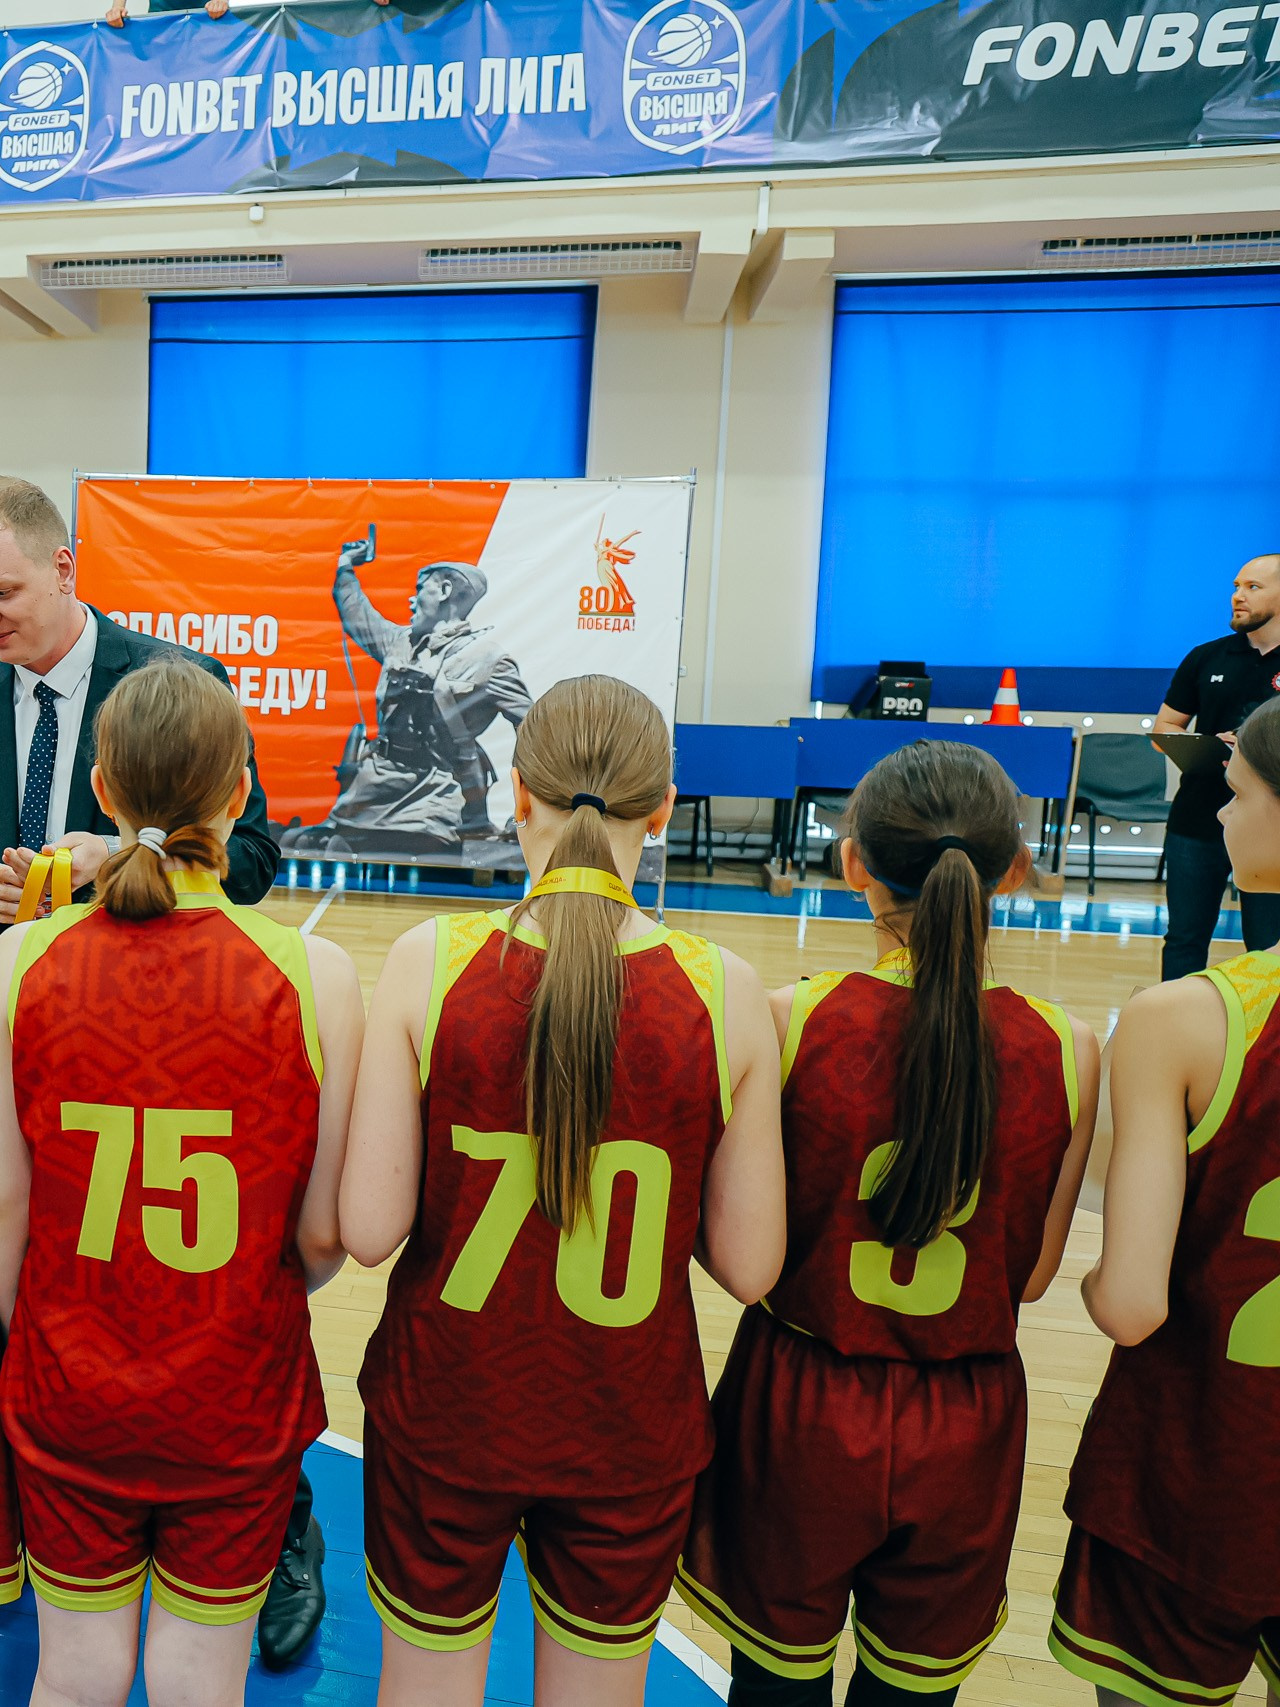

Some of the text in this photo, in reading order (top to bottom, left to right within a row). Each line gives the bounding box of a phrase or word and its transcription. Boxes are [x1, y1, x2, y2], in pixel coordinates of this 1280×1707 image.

[652, 72, 716, 87] FONBET
[120, 52, 587, 139] FONBET ВЫСШАЯ ЛИГА
[639, 91, 729, 122] ВЫСШАЯ
[13, 114, 65, 127] FONBET
[652, 119, 714, 137] ЛИГА
[1, 130, 75, 159] ВЫСШАЯ
[11, 159, 60, 174] ЛИГА
[579, 586, 609, 612] 80
[577, 617, 635, 633] ПОБЕДА!
[60, 1100, 240, 1274] 75
[439, 1124, 672, 1328] 70
